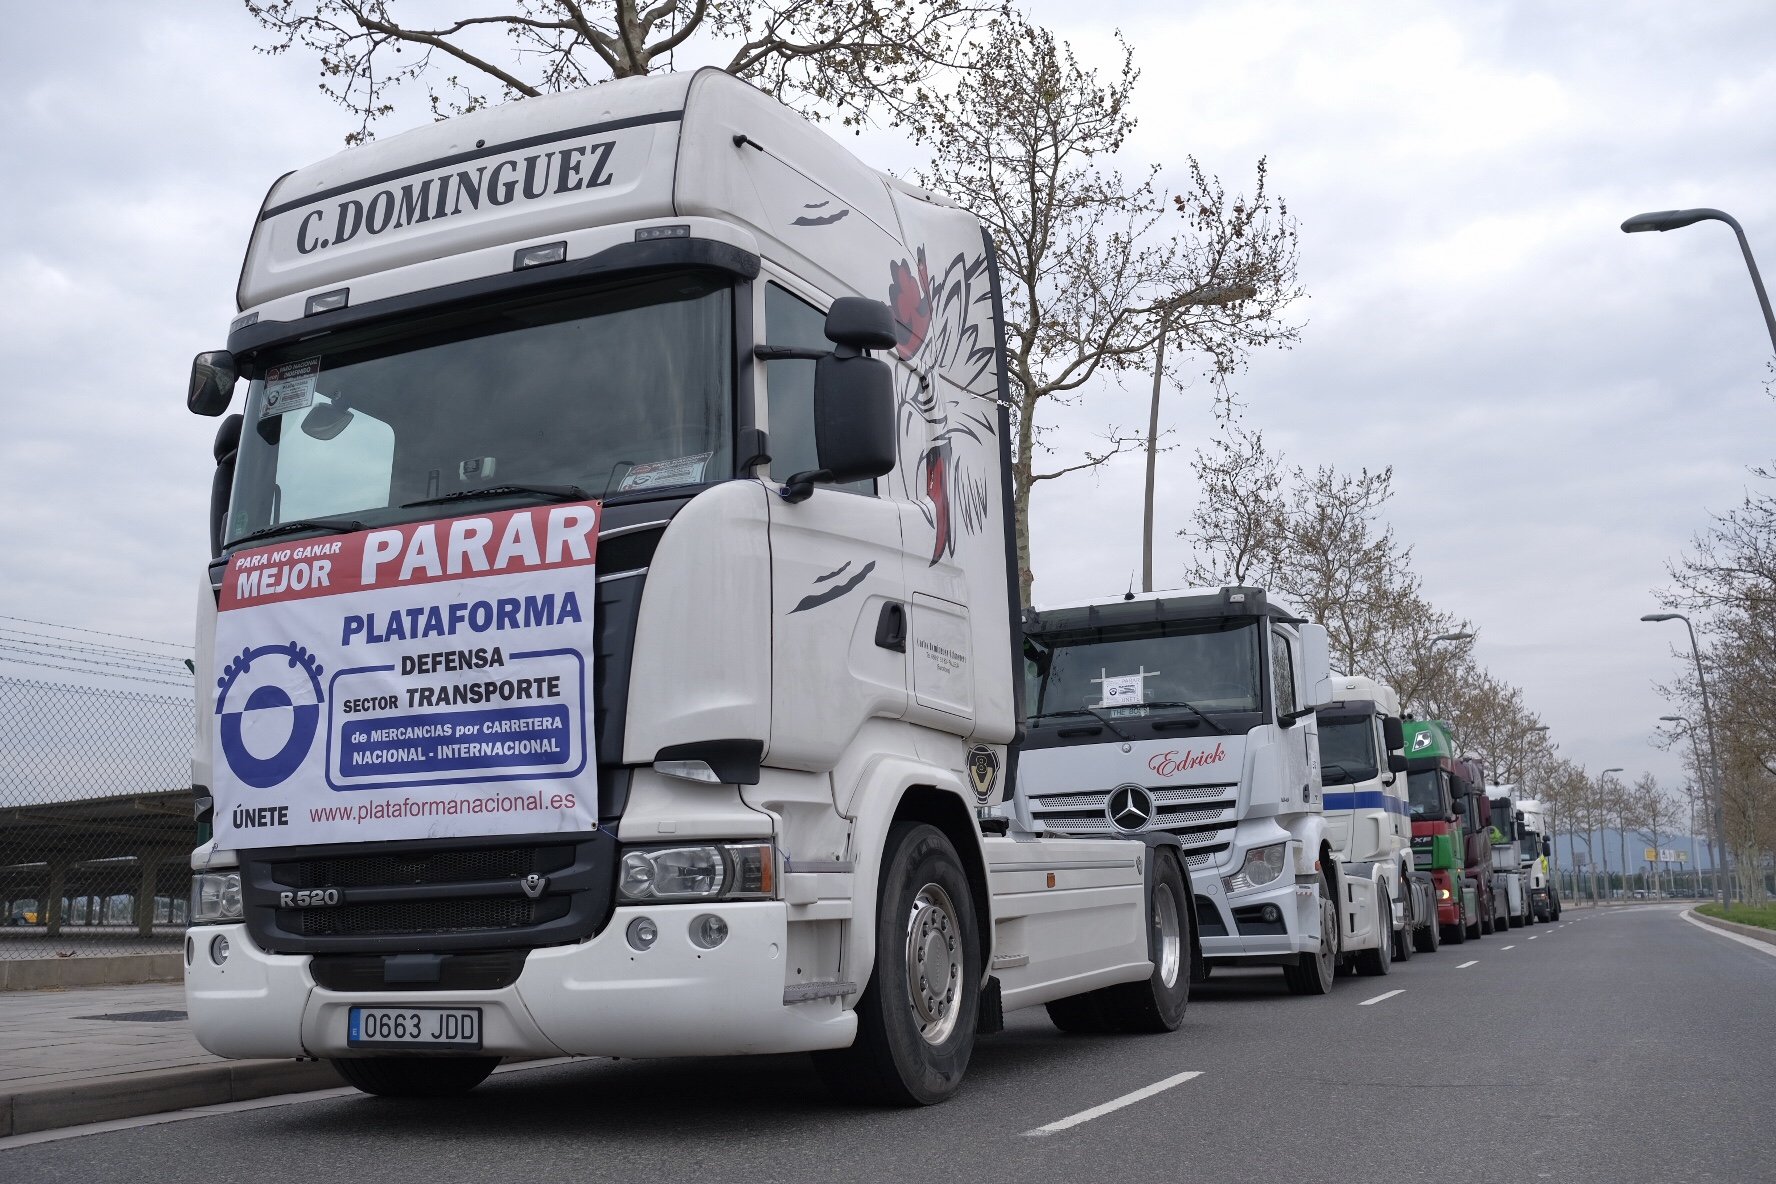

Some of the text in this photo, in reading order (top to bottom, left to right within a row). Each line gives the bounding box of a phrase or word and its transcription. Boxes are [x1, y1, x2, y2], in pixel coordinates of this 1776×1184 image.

[296, 140, 617, 254] C.DOMINGUEZ
[235, 542, 342, 570] PARA NO GANAR
[360, 505, 595, 586] PARAR
[236, 559, 332, 600] MEJOR
[341, 591, 583, 647] PLATAFORMA
[401, 647, 504, 676] DEFENSA
[343, 676, 561, 714] SECTOR TRANSPORTE
[351, 716, 563, 744] de MERCANCIAS por CARRETERA
[352, 746, 426, 765] NACIONAL
[437, 737, 560, 760] INTERNACIONAL
[1148, 742, 1226, 777] Edrick
[232, 804, 289, 829] ÚNETE
[309, 790, 576, 825] www.plataformanacional.es
[364, 1013, 475, 1039] 0663 JDD
